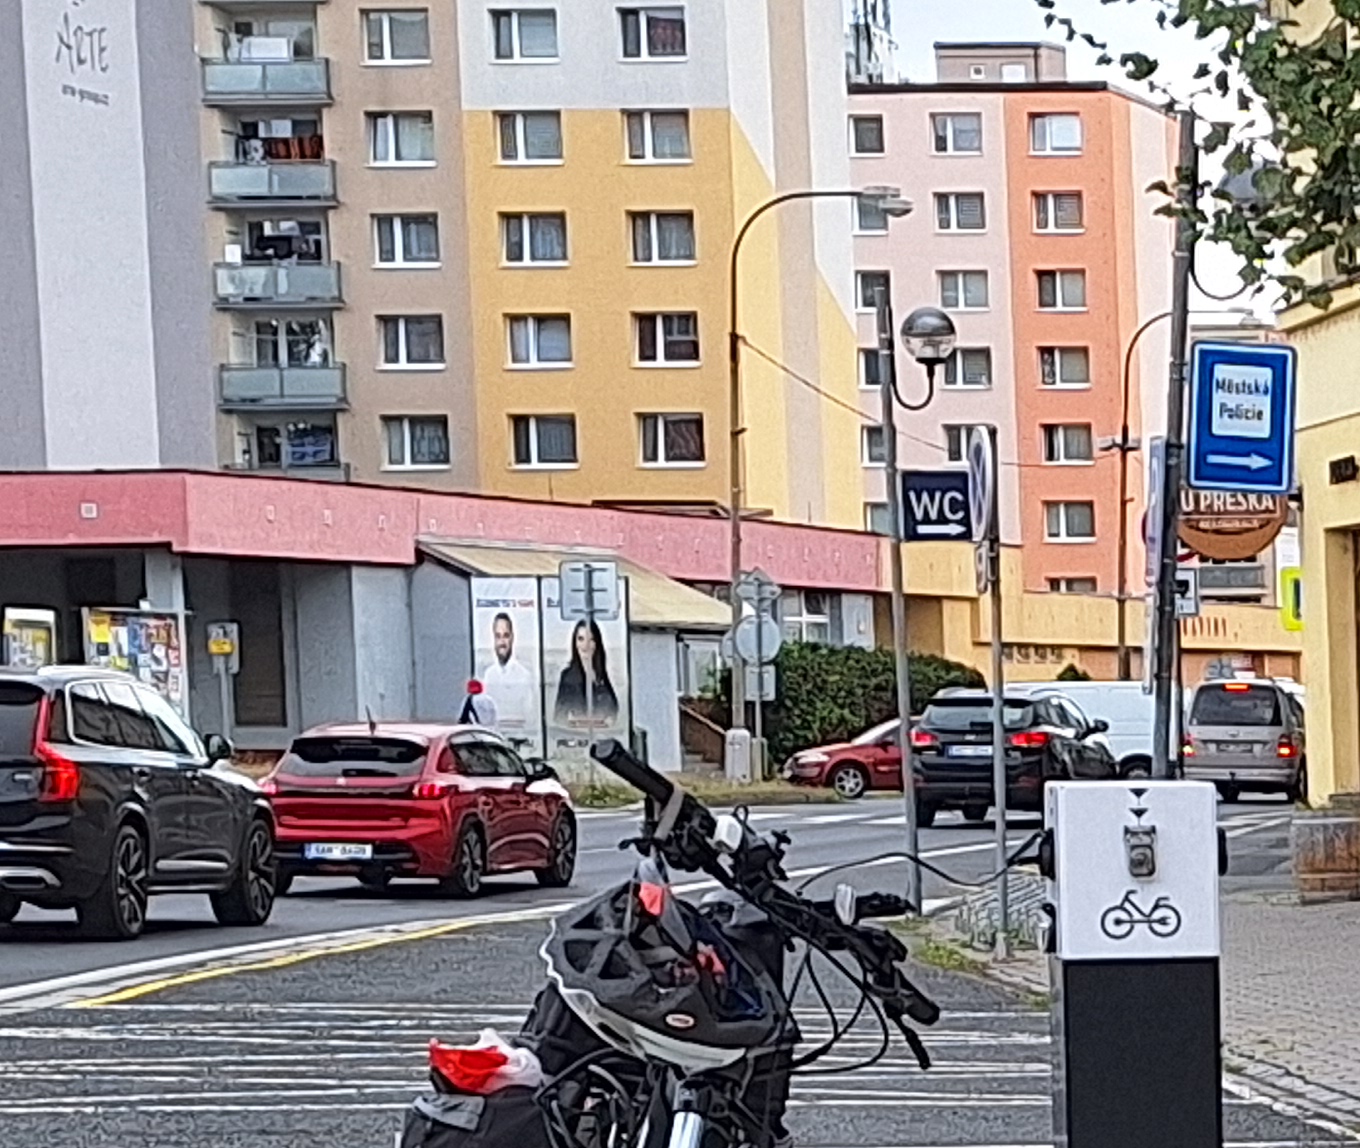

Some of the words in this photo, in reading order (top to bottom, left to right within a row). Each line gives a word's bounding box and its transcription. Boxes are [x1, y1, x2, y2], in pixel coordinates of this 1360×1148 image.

[1214, 377, 1270, 396] Městská
[1218, 402, 1264, 421] Policie
[907, 489, 966, 522] WC
[1180, 489, 1195, 512] U
